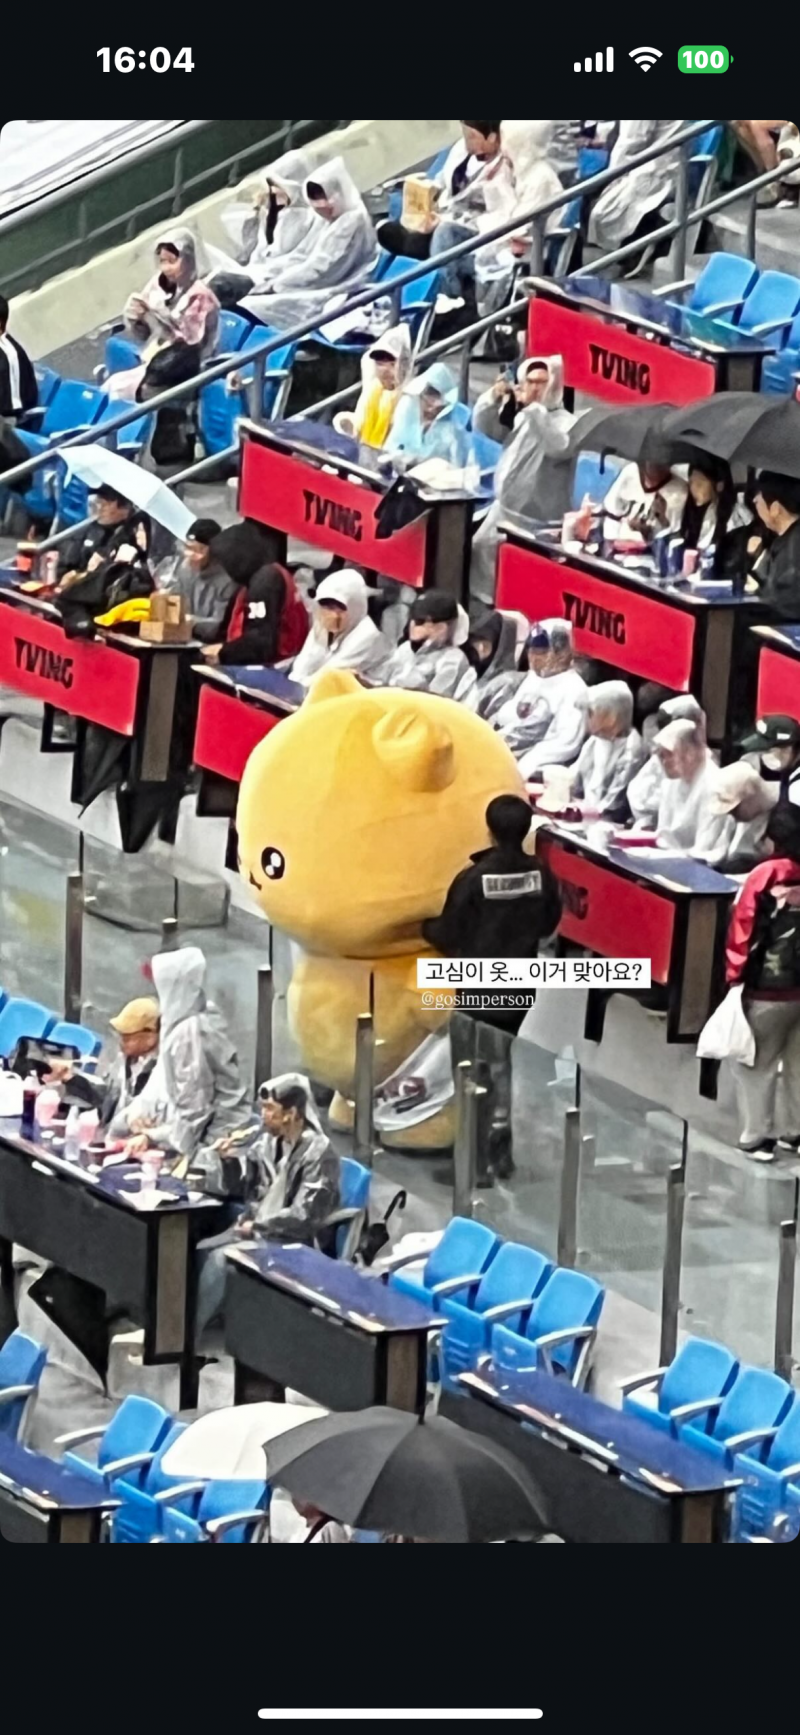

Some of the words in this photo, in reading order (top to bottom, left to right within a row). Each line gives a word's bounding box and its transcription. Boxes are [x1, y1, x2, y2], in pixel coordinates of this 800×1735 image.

[96, 46, 195, 74] 16:04
[682, 50, 725, 69] 100
[588, 342, 651, 396] TVING
[302, 488, 363, 542] TVING
[561, 590, 627, 646] TVING
[14, 635, 74, 689] TVING
